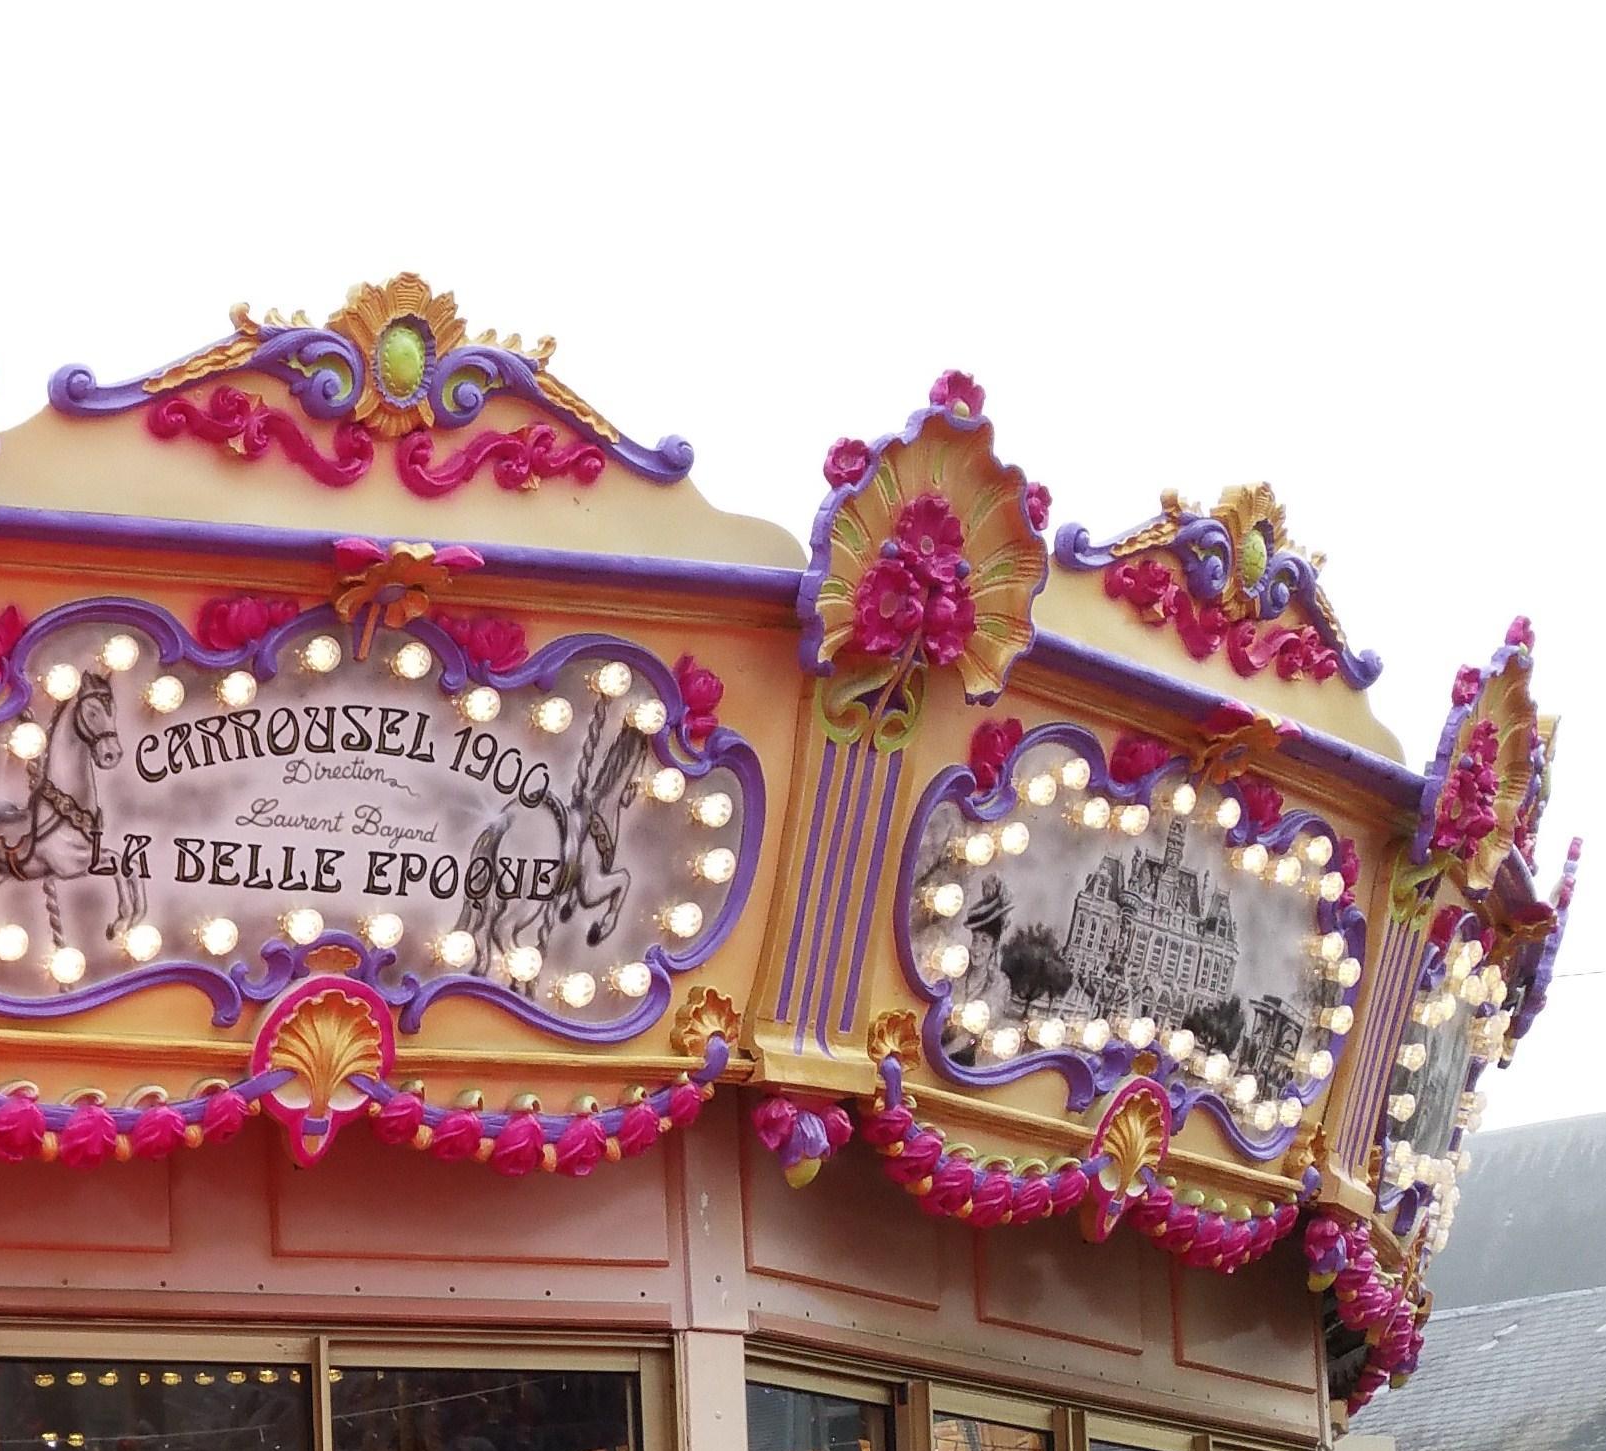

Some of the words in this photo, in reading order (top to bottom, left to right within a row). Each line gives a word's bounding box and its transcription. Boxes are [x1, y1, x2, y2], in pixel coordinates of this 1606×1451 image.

[135, 704, 436, 783] CARROUSEL
[449, 726, 550, 809] 1900
[281, 756, 395, 786] Direction
[235, 798, 345, 834] Laurent
[351, 804, 439, 849] Bayard
[88, 830, 152, 879] LA
[173, 837, 346, 894] BELLE
[362, 850, 562, 910] EPOQUE
